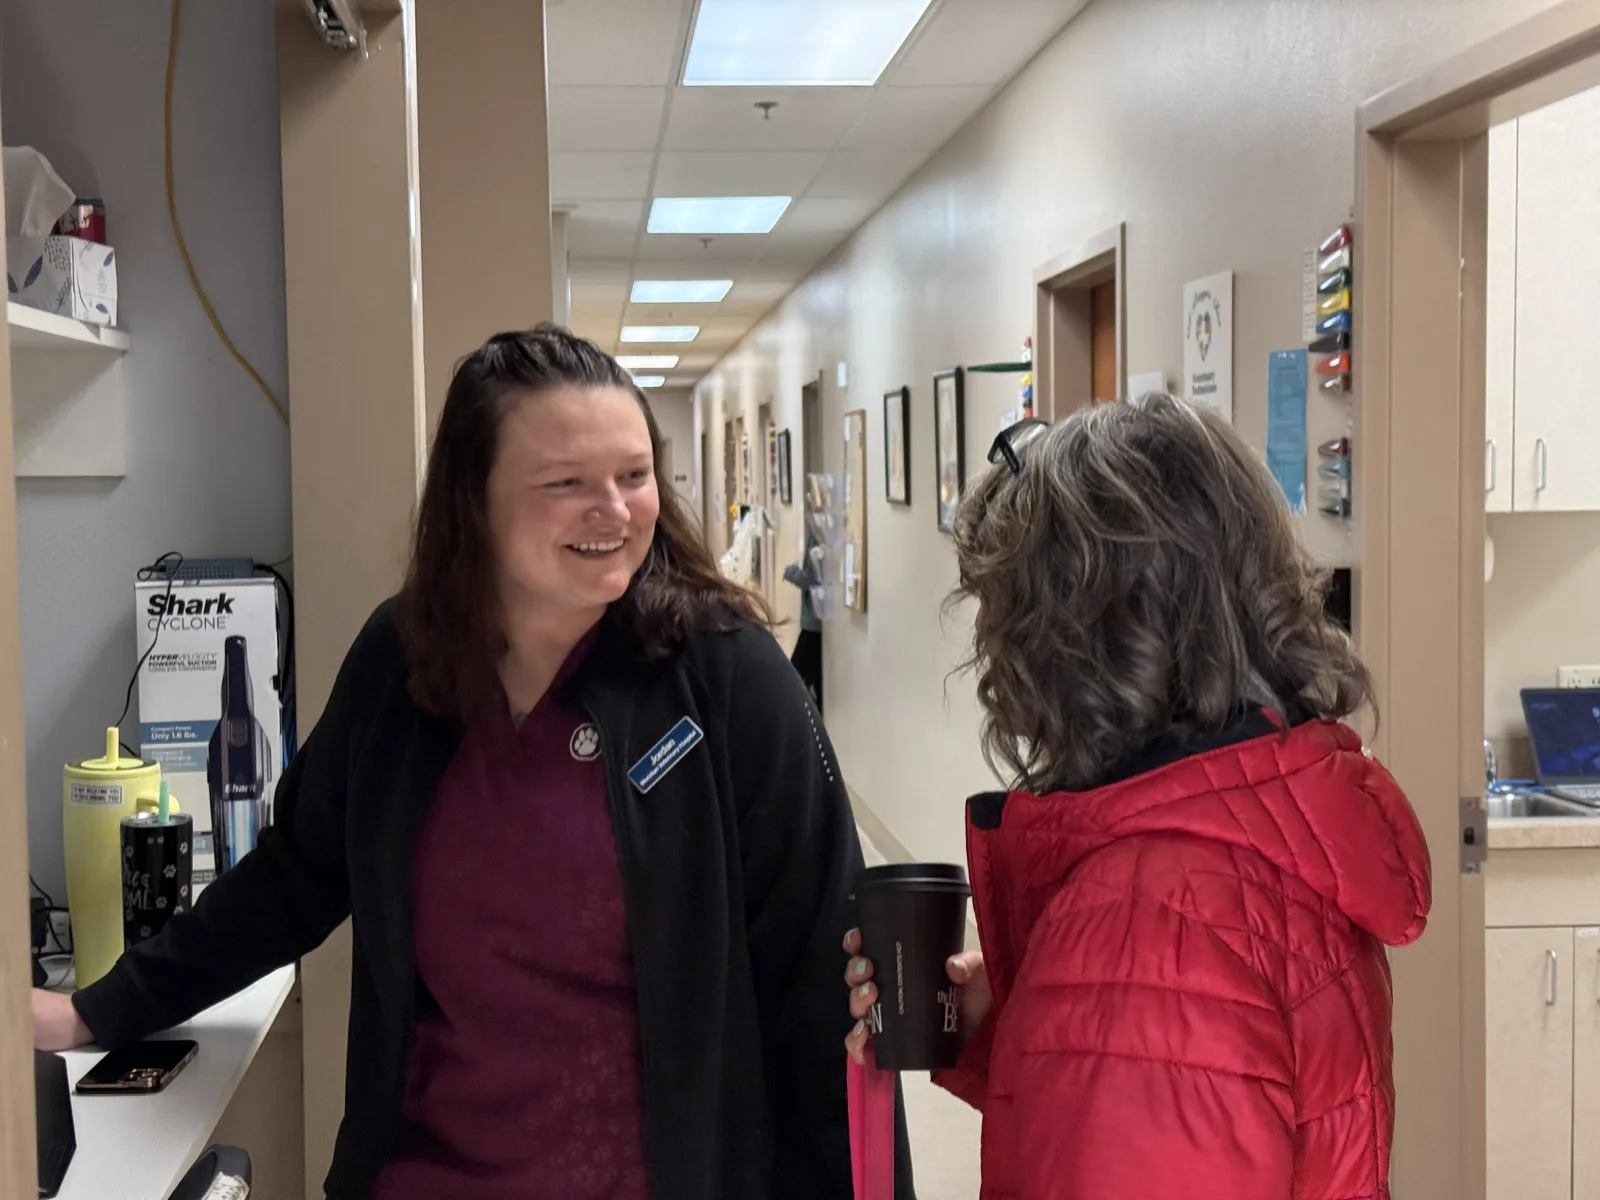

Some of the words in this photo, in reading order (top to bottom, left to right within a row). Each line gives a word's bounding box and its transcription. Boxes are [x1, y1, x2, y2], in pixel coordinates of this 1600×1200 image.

[147, 592, 235, 616] Shark
[147, 616, 226, 631] CYCLONE
[151, 732, 170, 740] Only
[224, 782, 256, 794] Shark
